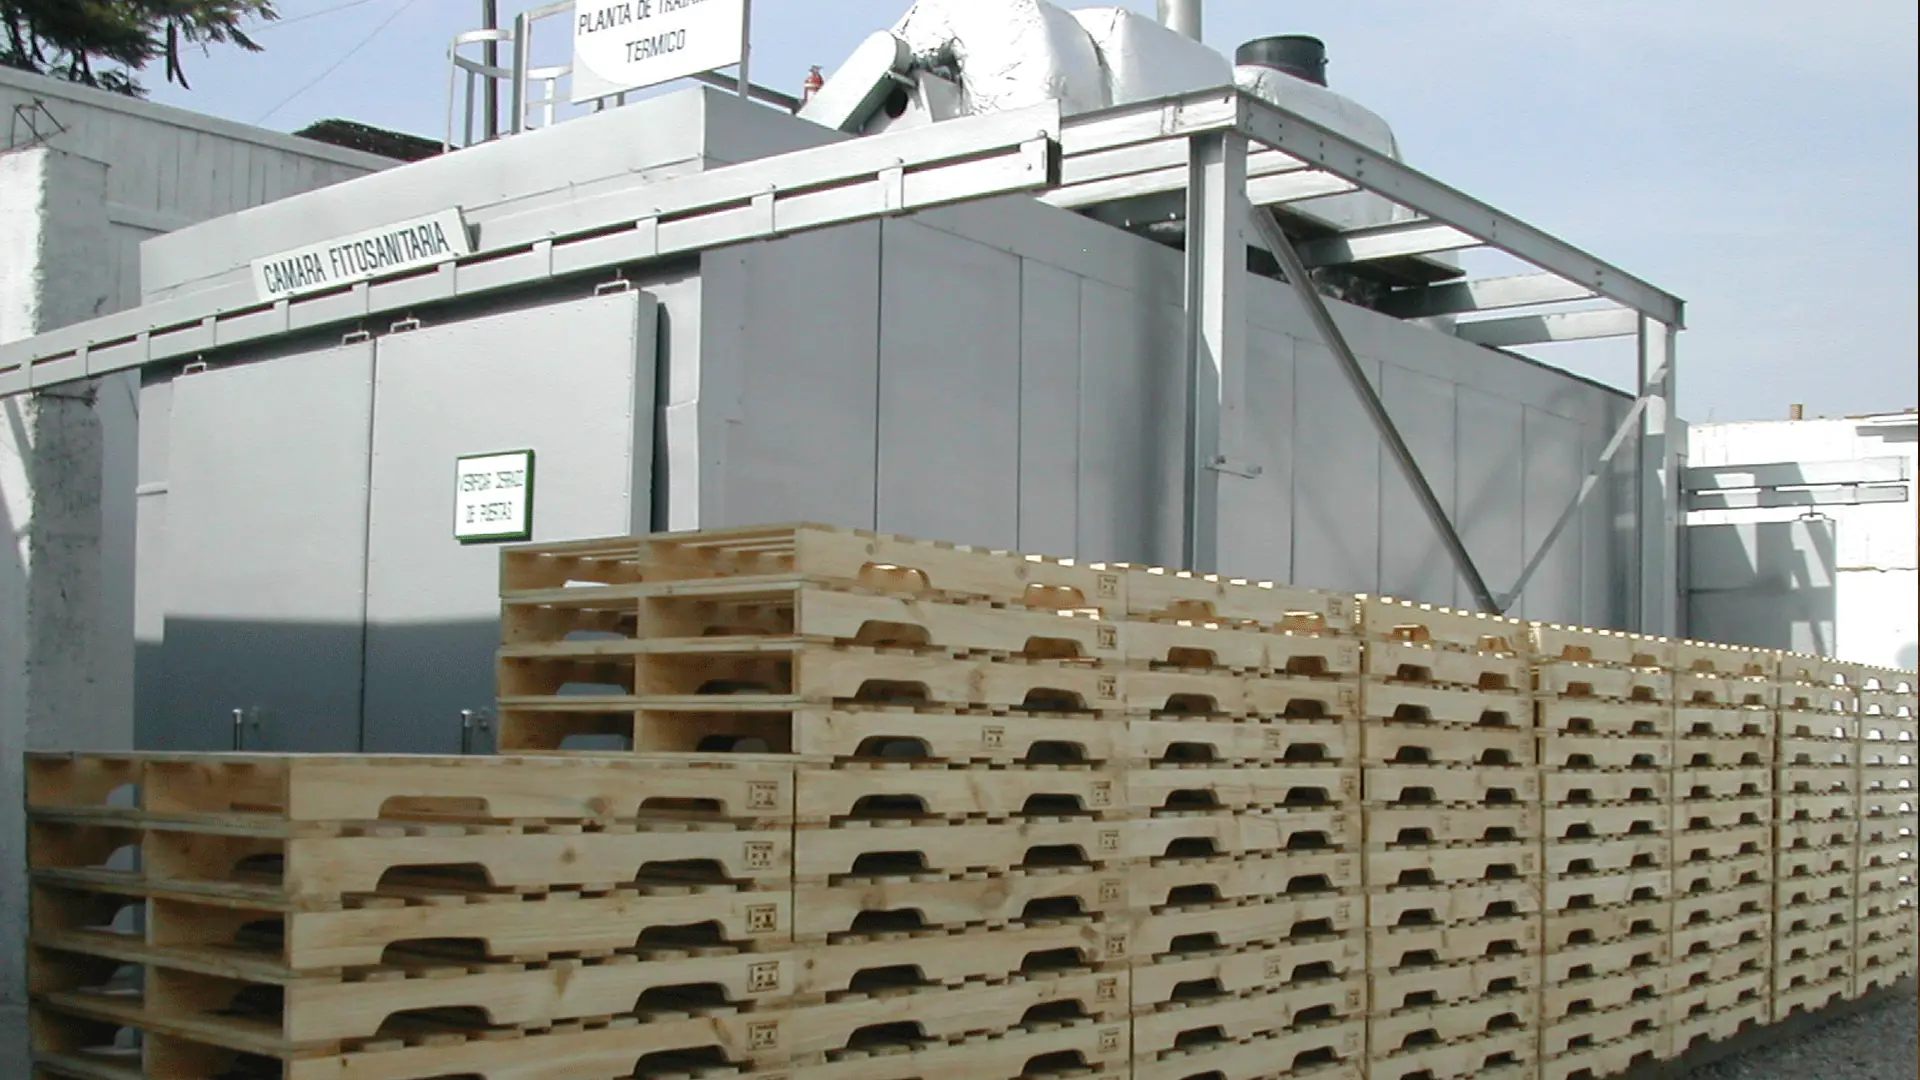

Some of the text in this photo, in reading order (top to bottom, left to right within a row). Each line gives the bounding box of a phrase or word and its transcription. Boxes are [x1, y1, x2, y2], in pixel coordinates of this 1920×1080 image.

[578, 3, 632, 36] PLANTA
[637, 0, 652, 20] DE
[625, 28, 686, 63] TERMICO
[263, 221, 450, 293] CAMARA FITOSANITARIA
